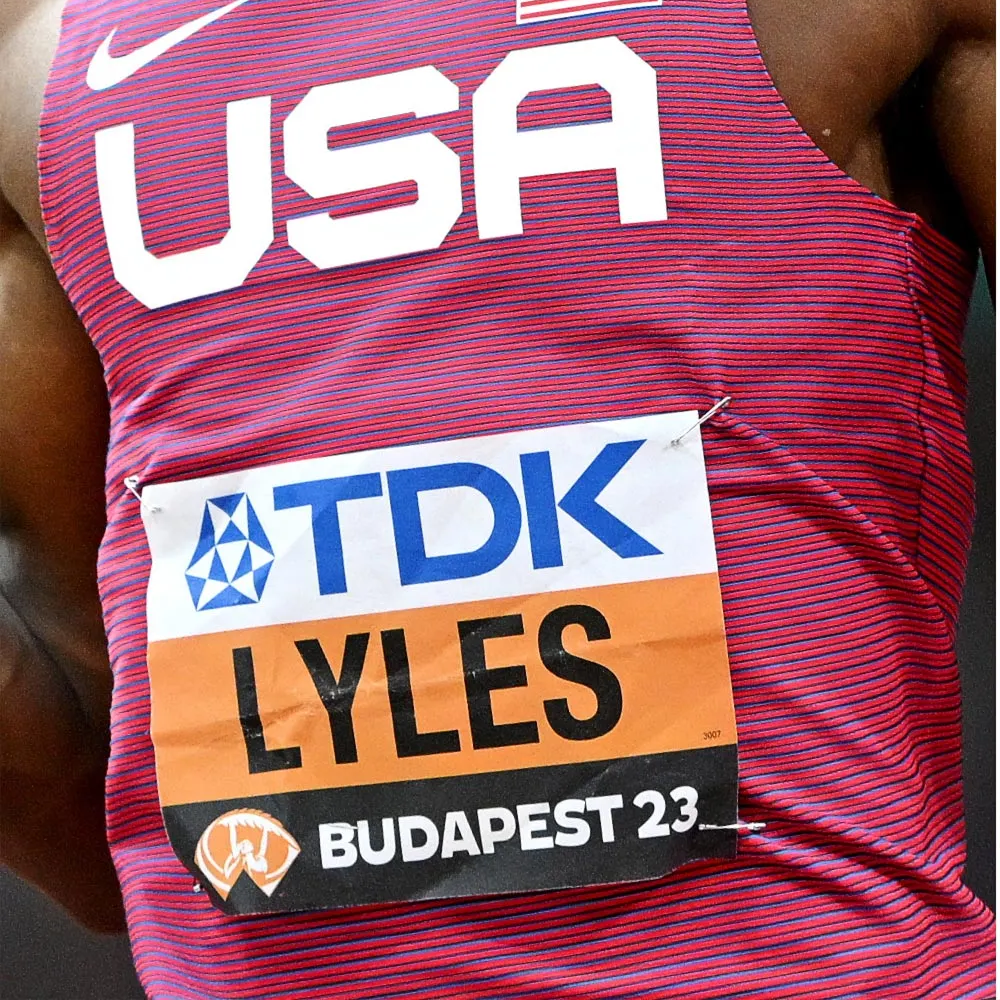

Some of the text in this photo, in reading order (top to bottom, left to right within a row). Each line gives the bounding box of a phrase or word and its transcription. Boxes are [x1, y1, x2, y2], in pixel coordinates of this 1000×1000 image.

[95, 35, 667, 309] USA
[274, 439, 663, 595] TDK
[232, 604, 624, 774] LYLES
[703, 730, 721, 740] 3007
[318, 786, 700, 869] BUDAPEST 23
